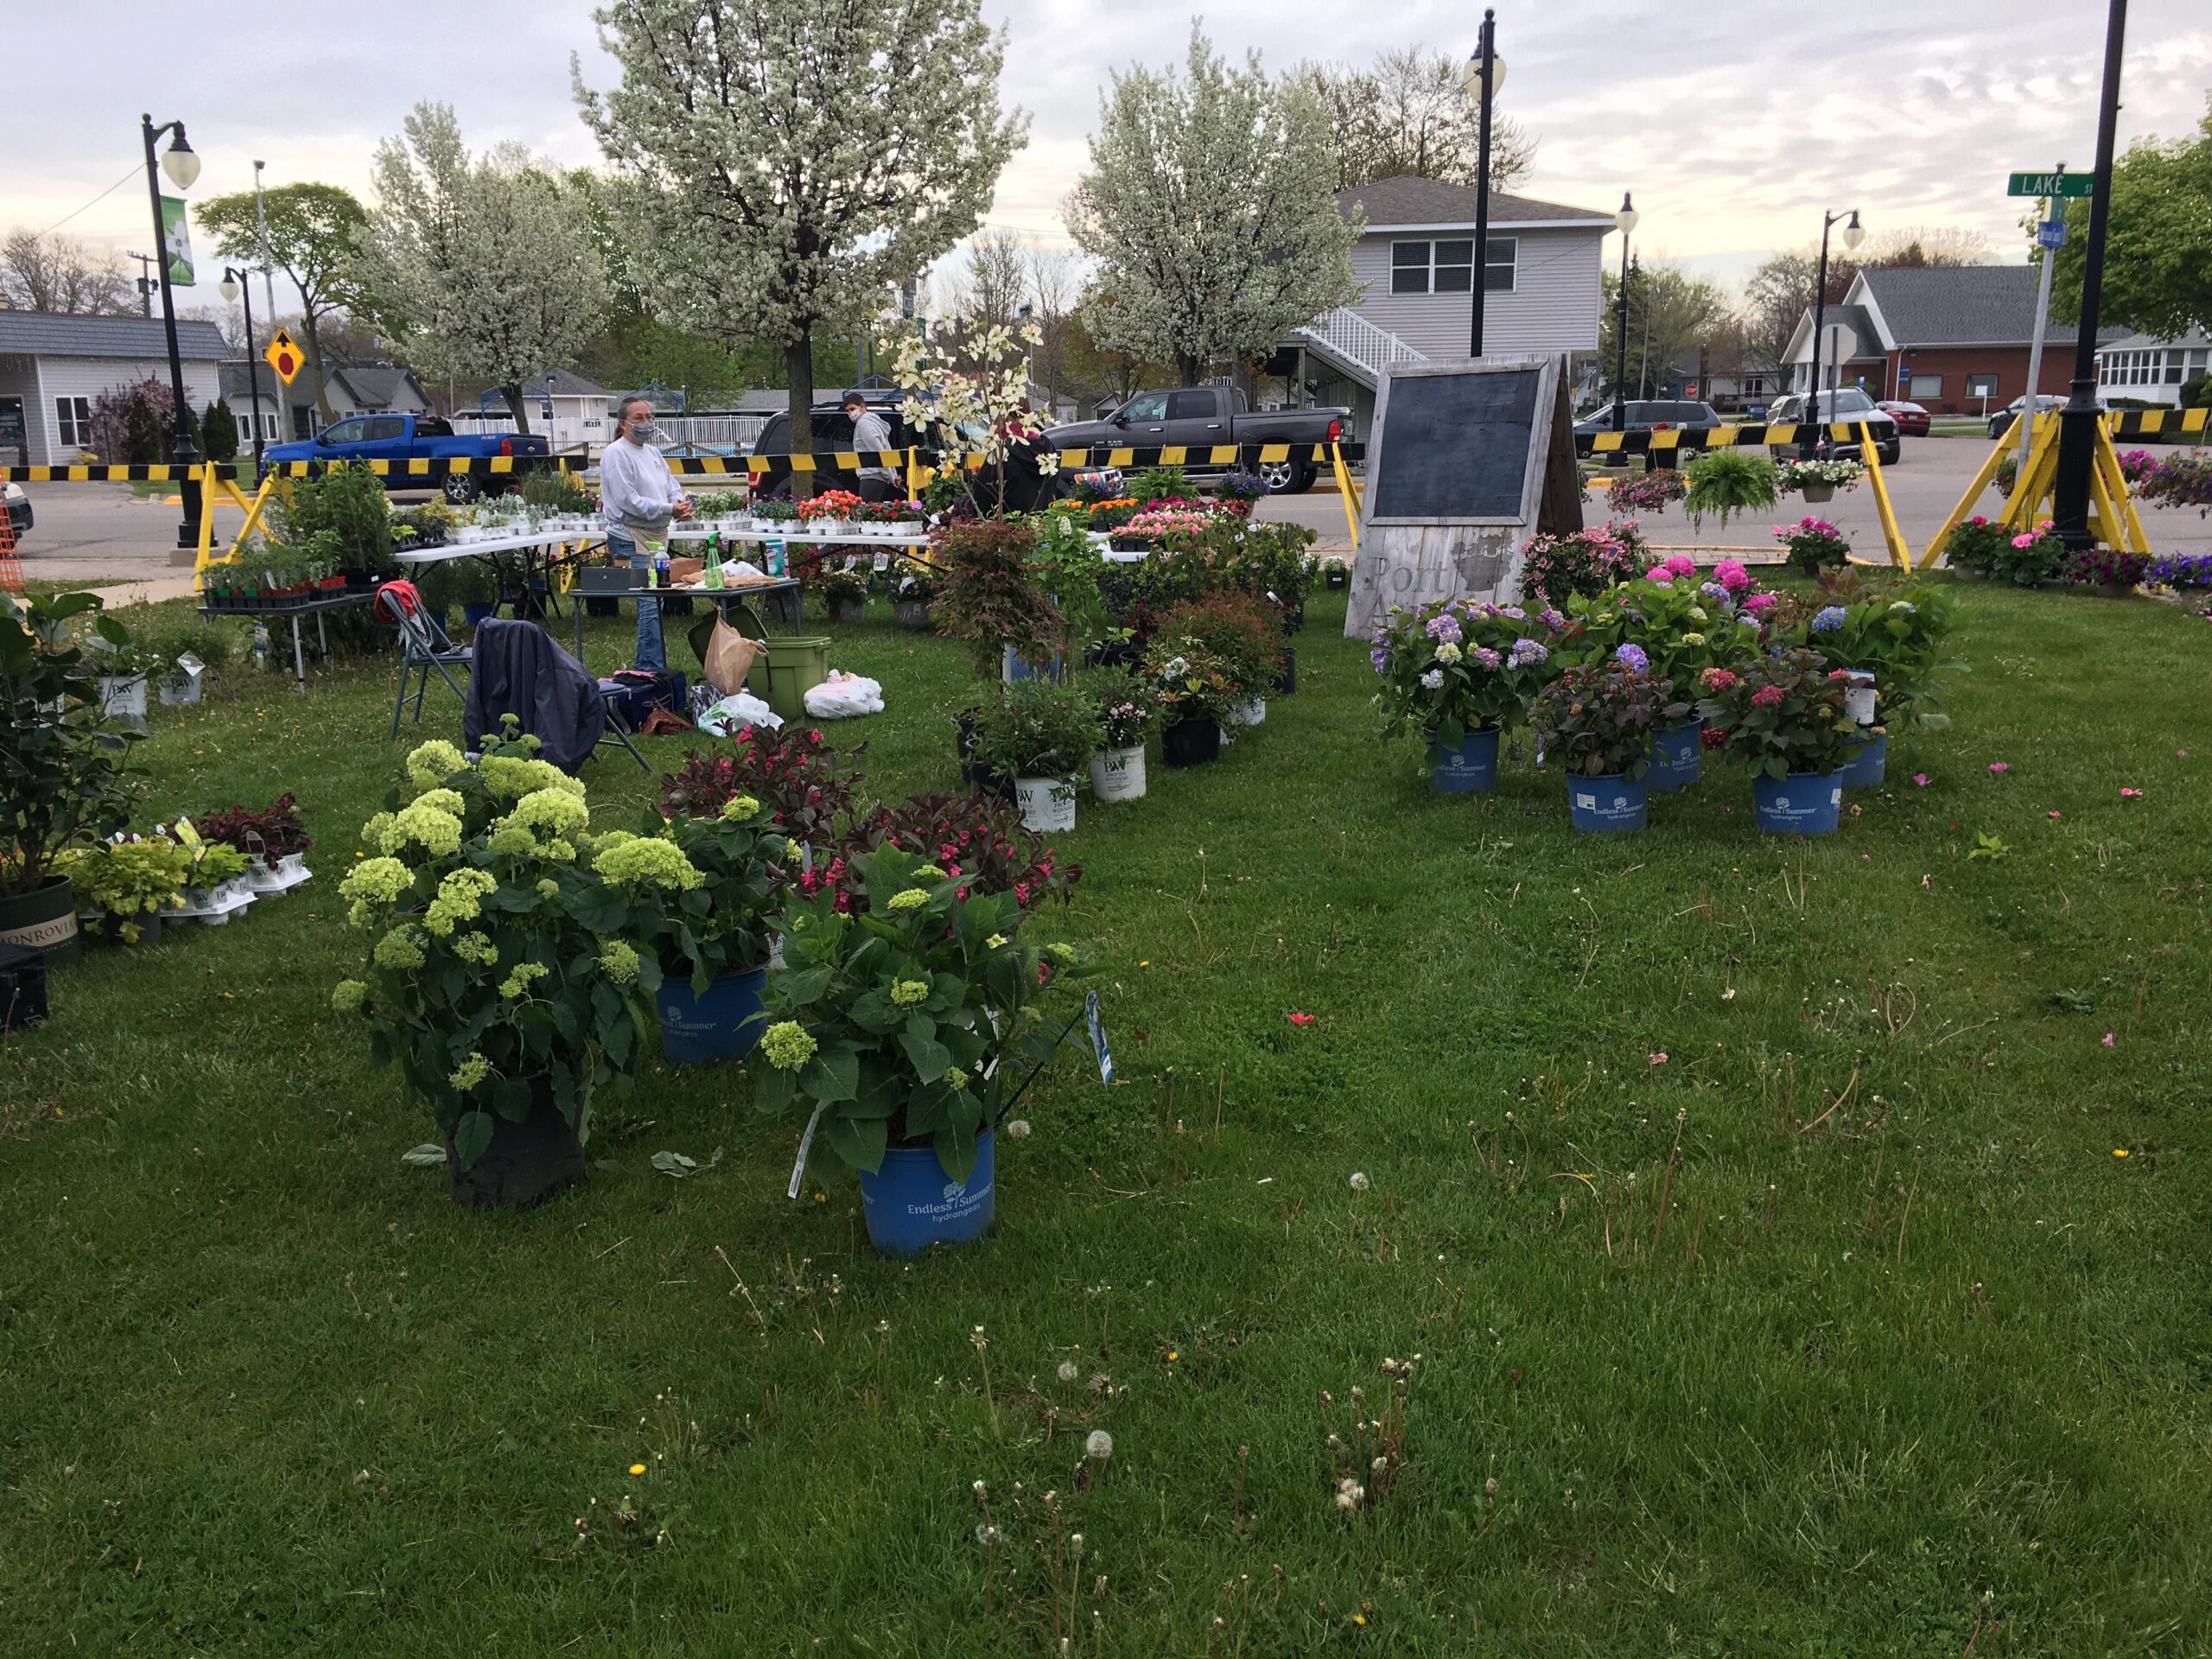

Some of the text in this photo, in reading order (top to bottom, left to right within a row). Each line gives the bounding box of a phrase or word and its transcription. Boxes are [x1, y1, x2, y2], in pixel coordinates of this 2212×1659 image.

[2021, 175, 2064, 194] LAKE
[1363, 556, 1447, 593] Port
[1759, 805, 1781, 814] Endless
[0, 921, 75, 945] ONROVIA
[678, 1020, 715, 1030] Summer
[908, 1183, 992, 1215] Endless Summer
[932, 1203, 981, 1224] hydrangeas
